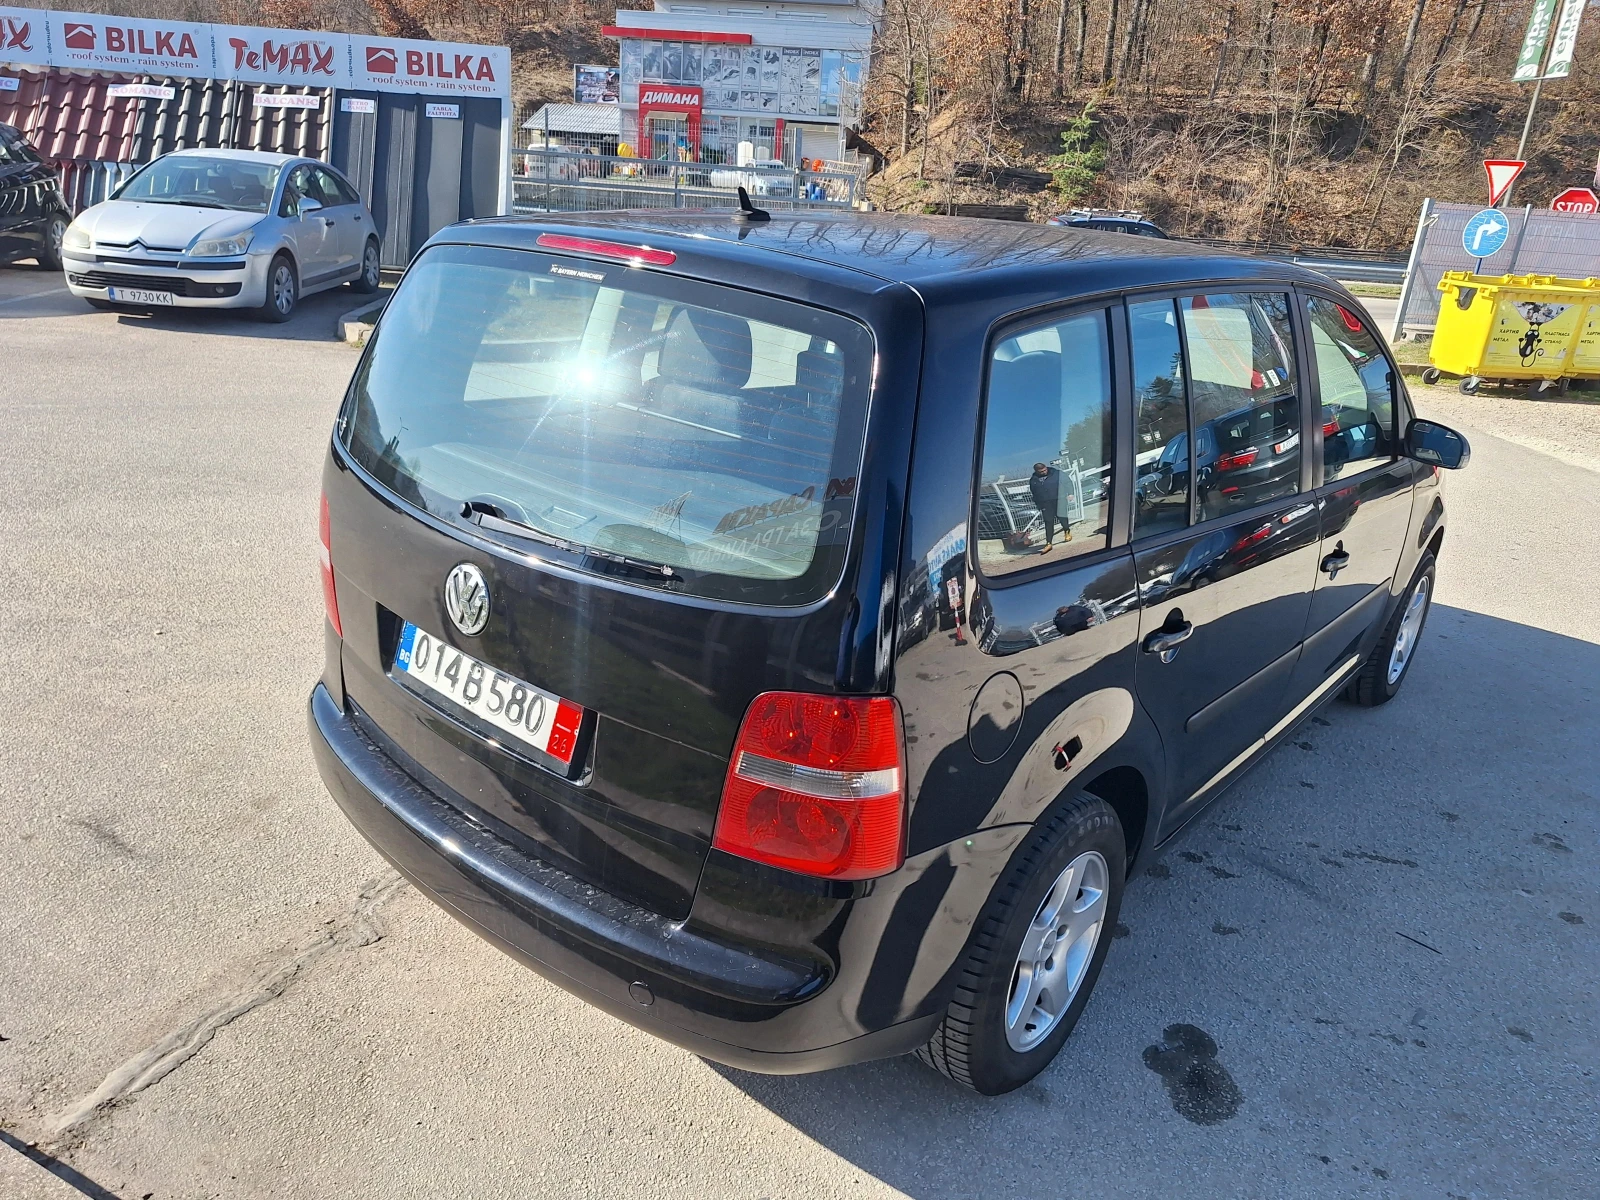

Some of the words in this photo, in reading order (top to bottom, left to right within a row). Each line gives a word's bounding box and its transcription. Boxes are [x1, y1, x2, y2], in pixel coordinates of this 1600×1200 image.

[106, 27, 198, 59] BILKA
[72, 52, 92, 61] roof
[94, 54, 129, 65] system
[137, 57, 158, 67] rain
[160, 60, 195, 70] system
[228, 37, 336, 76] TeMAX
[406, 50, 496, 82] BILKA
[372, 75, 395, 85] roof
[395, 78, 429, 89] system
[436, 80, 456, 91] rain
[458, 83, 492, 94] system
[641, 91, 699, 106] ДИМАНА
[1556, 201, 1593, 213] STOP
[399, 648, 410, 664] BG
[551, 734, 567, 753] 26
